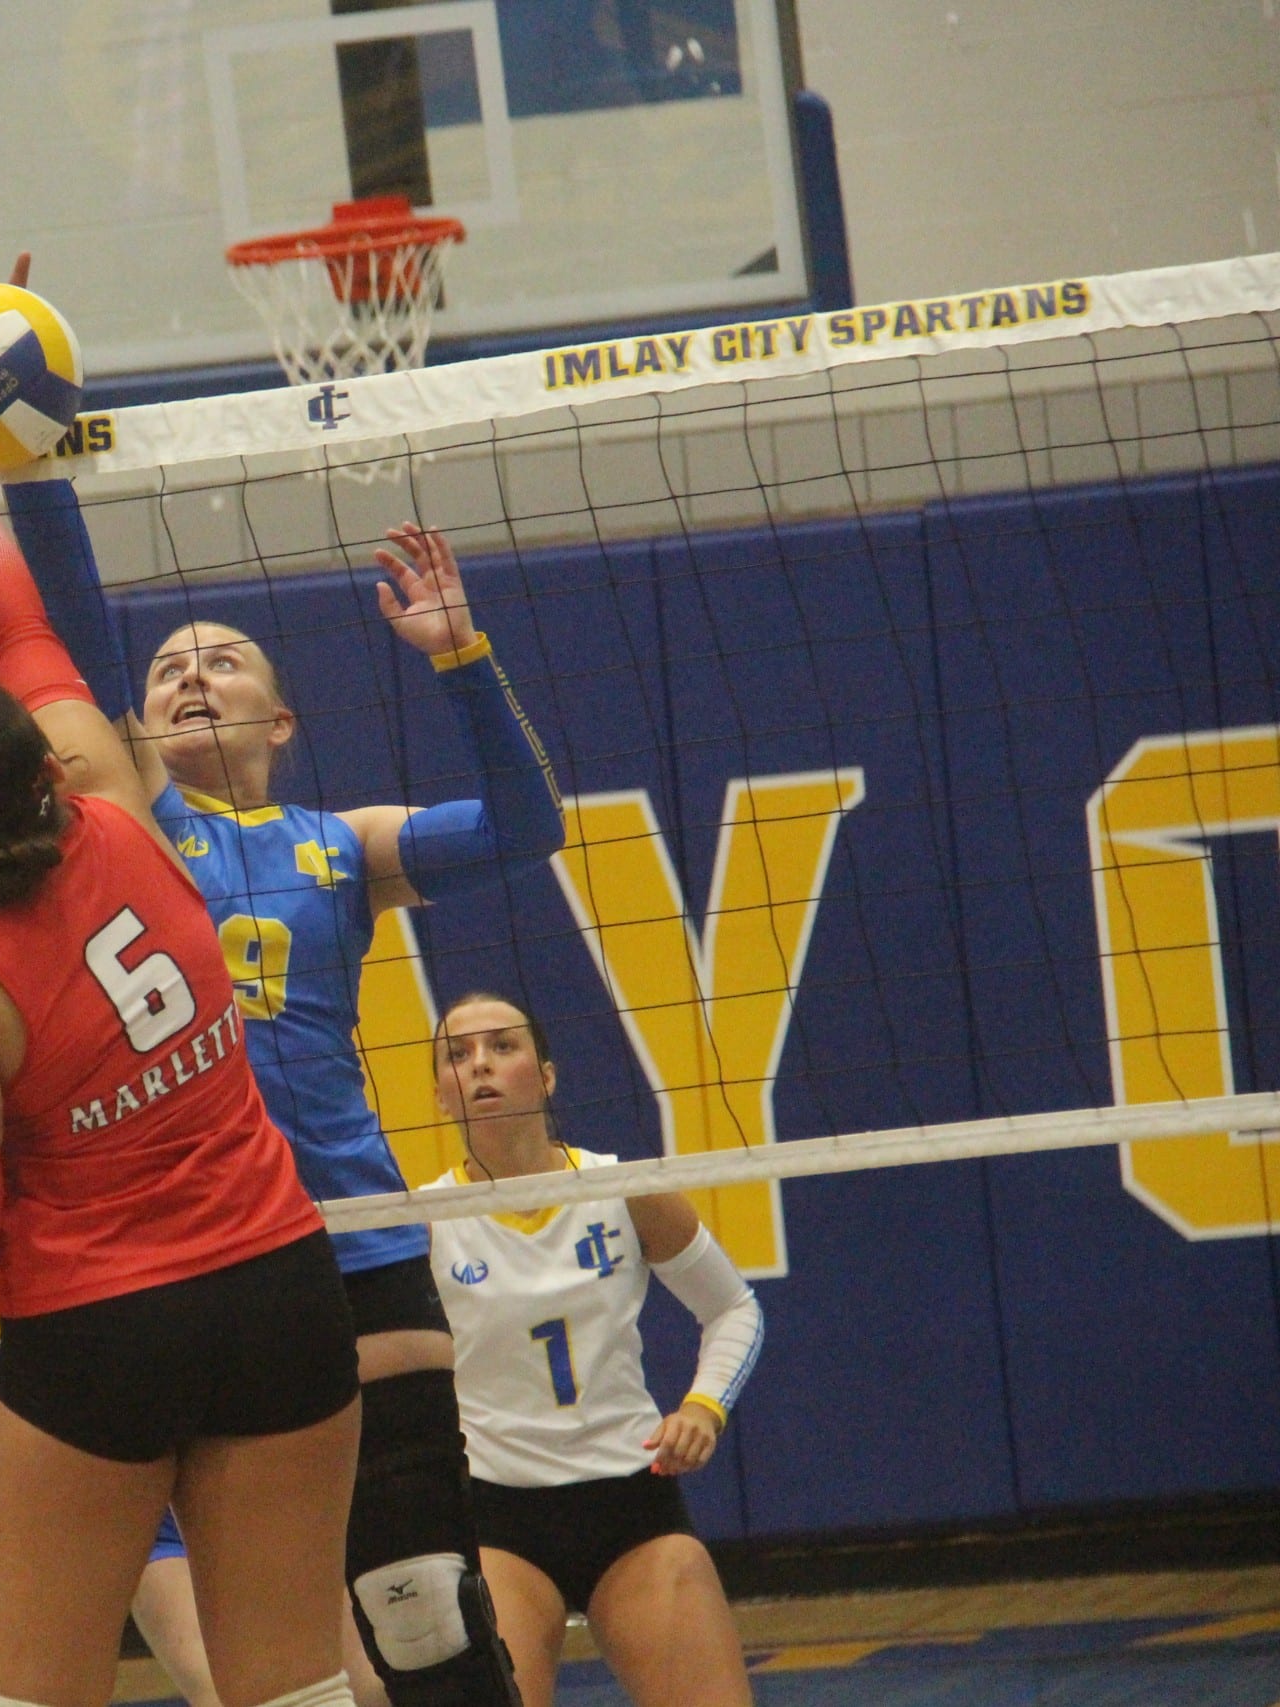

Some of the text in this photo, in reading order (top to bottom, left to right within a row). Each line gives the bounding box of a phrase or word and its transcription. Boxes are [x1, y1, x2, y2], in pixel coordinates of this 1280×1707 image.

[544, 281, 1090, 390] IMLAY CITY SPARTANS
[84, 904, 197, 1054] 6
[218, 913, 293, 1021] 9
[529, 1314, 581, 1409] 1
